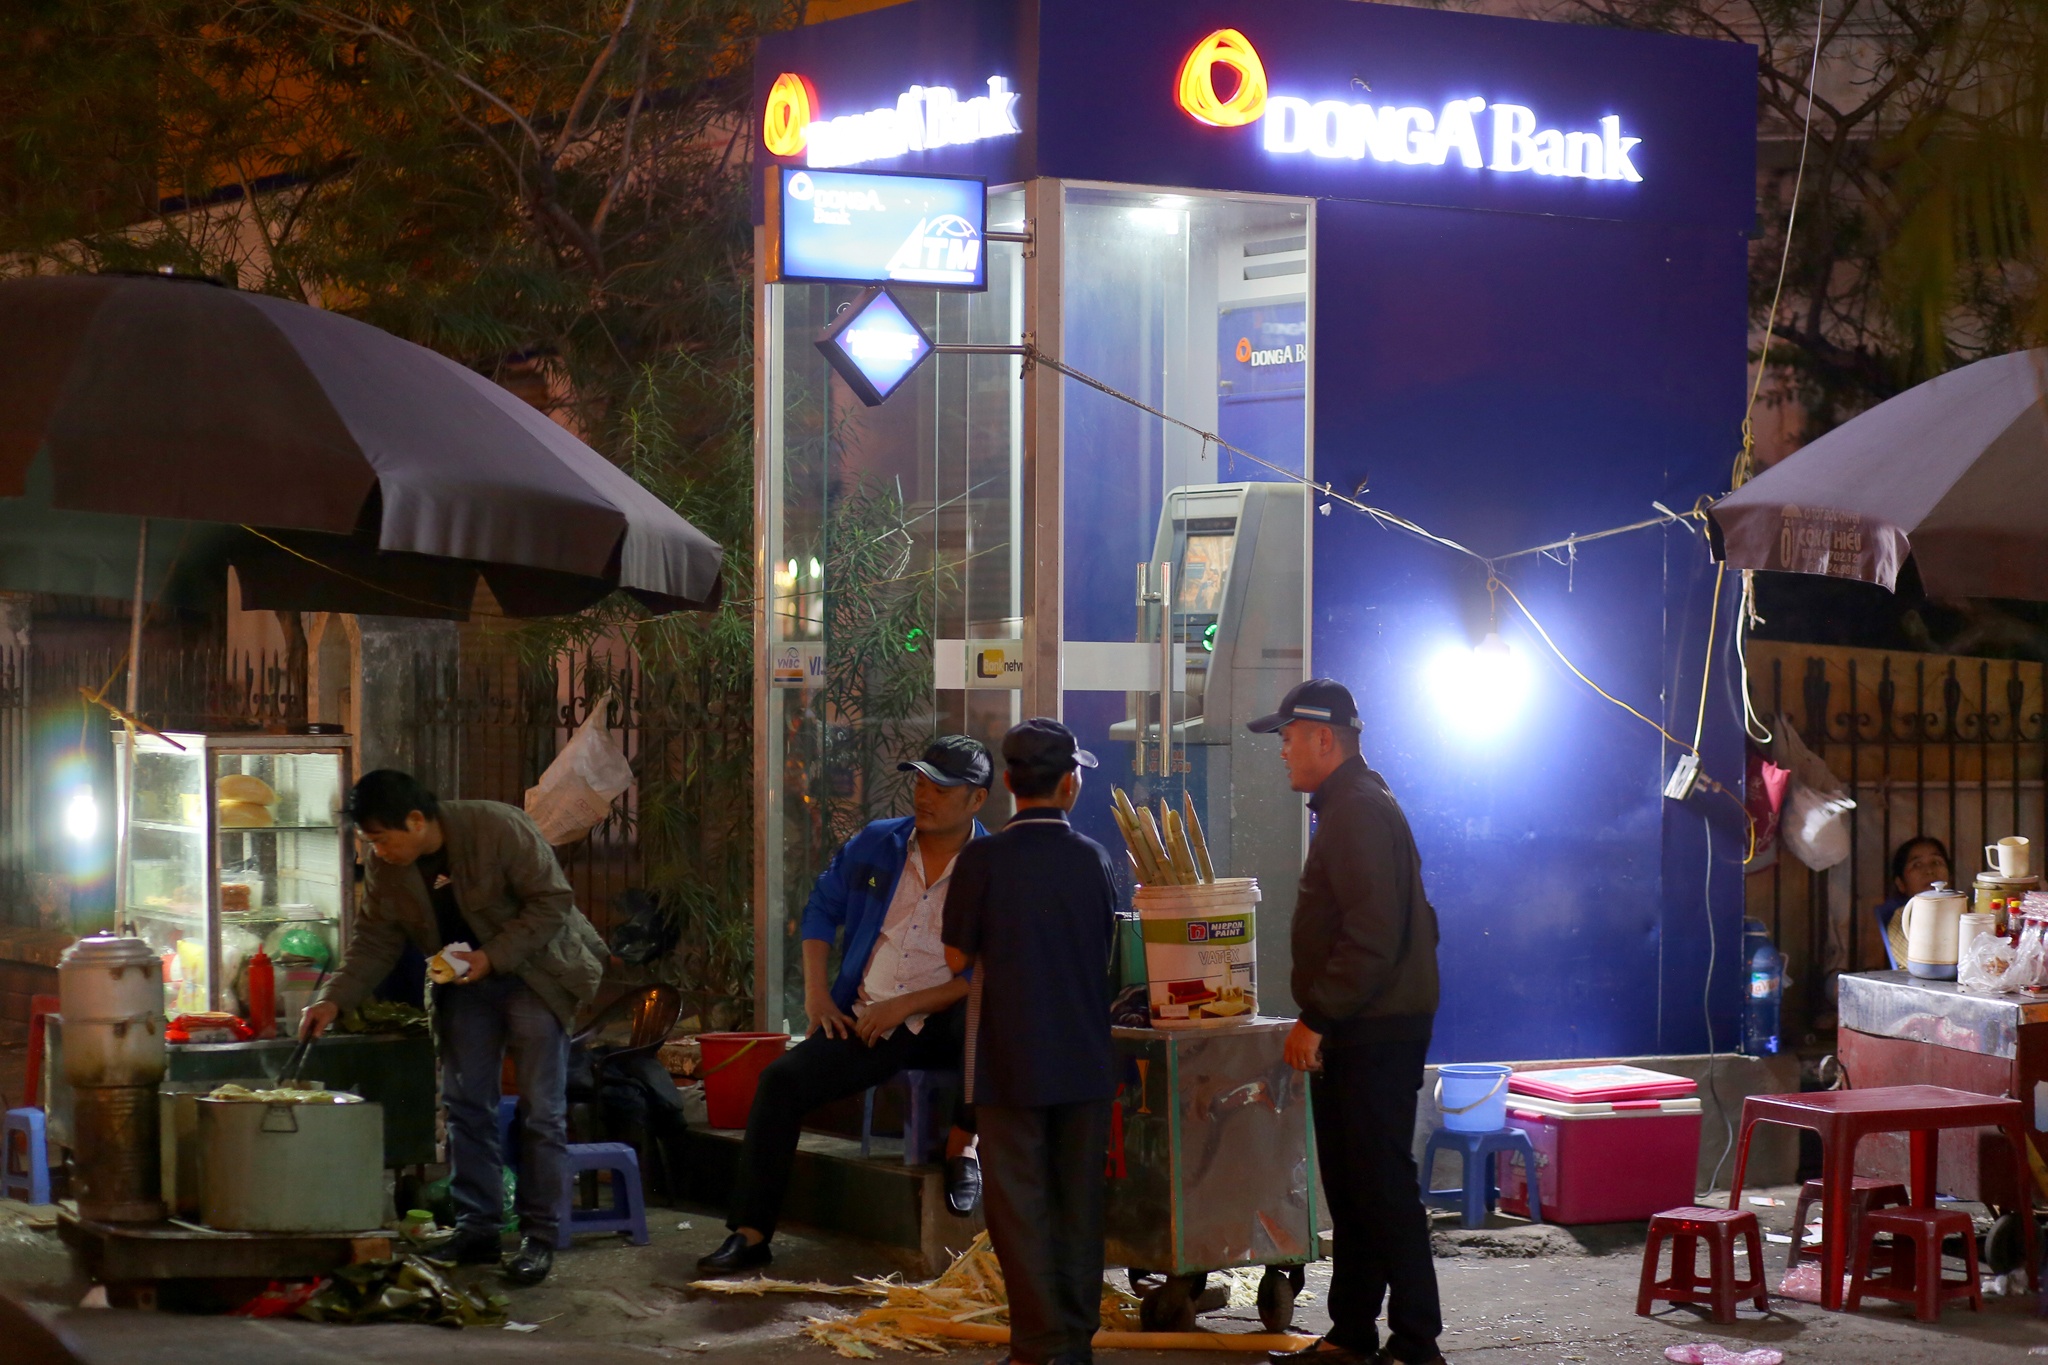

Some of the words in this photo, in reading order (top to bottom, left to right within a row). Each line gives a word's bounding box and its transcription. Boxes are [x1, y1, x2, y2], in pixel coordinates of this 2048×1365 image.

[1488, 104, 1643, 183] Bank
[885, 217, 980, 271] ATM
[777, 658, 800, 668] VNBC
[808, 656, 824, 675] VI
[1211, 921, 1243, 931] NIPPON
[1215, 928, 1241, 938] PAINT
[1198, 949, 1239, 965] VATEX
